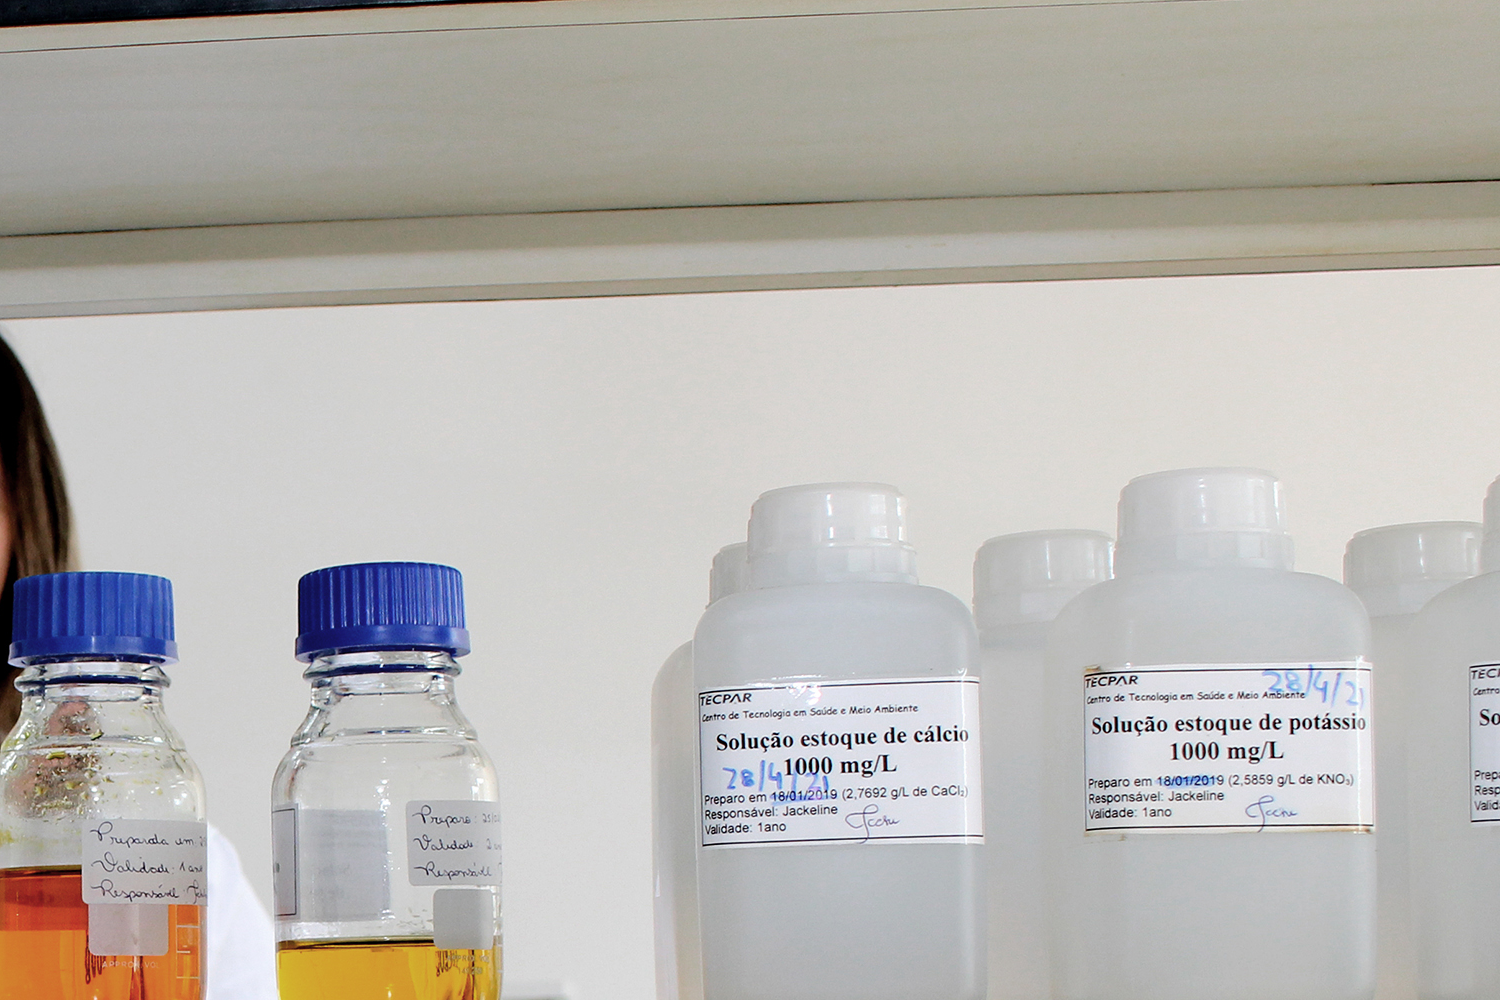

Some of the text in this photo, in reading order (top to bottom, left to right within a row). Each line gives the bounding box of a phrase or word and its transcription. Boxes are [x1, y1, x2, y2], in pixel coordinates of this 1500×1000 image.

[1085, 675, 1138, 688] TECPAR
[1471, 668, 1500, 680] TEC
[1262, 664, 1364, 709] 28/4/21
[1473, 687, 1500, 696] Centro
[700, 692, 752, 706] TECPAR
[1087, 694, 1111, 704] Centro
[1113, 693, 1125, 702] de
[1128, 692, 1178, 703] Tecnologia
[1180, 692, 1193, 700] em
[1197, 690, 1225, 700] Saúde
[1237, 691, 1259, 699] Meio
[1262, 691, 1306, 699] Ambiente
[702, 712, 726, 722] Centro
[728, 711, 739, 720] de
[743, 709, 791, 720] Tecnologia
[793, 709, 807, 717] em
[810, 706, 837, 716] Saúde
[848, 705, 872, 715] Meio
[874, 704, 919, 713] Ambiente
[1092, 712, 1366, 736] Solução estoque de potássio
[716, 725, 969, 753] Solução estoque de cálcio
[1170, 741, 1284, 764] 1000 mg/L
[784, 754, 897, 778] 1000 mg/L
[722, 760, 830, 792] 28/4/21
[1088, 778, 1130, 789] Preparo
[1134, 777, 1152, 786] em
[1157, 774, 1224, 786] 18/01/2019
[1228, 774, 1274, 788] (2,5859
[1277, 774, 1295, 788] g/L
[1298, 774, 1313, 785] de
[704, 794, 745, 807] Preparo
[749, 793, 767, 802] em
[771, 788, 838, 802] 18/01/2019
[842, 786, 887, 801] (2,7692
[891, 786, 910, 800] g/L
[912, 786, 928, 797] de
[1088, 790, 1224, 804] Responsável: Jackeline
[1474, 799, 1500, 811] Valid
[704, 805, 838, 821] Responsável: Jackeline
[1088, 807, 1172, 820] Validade: 1ano
[704, 822, 787, 835] Validade: 1ano
